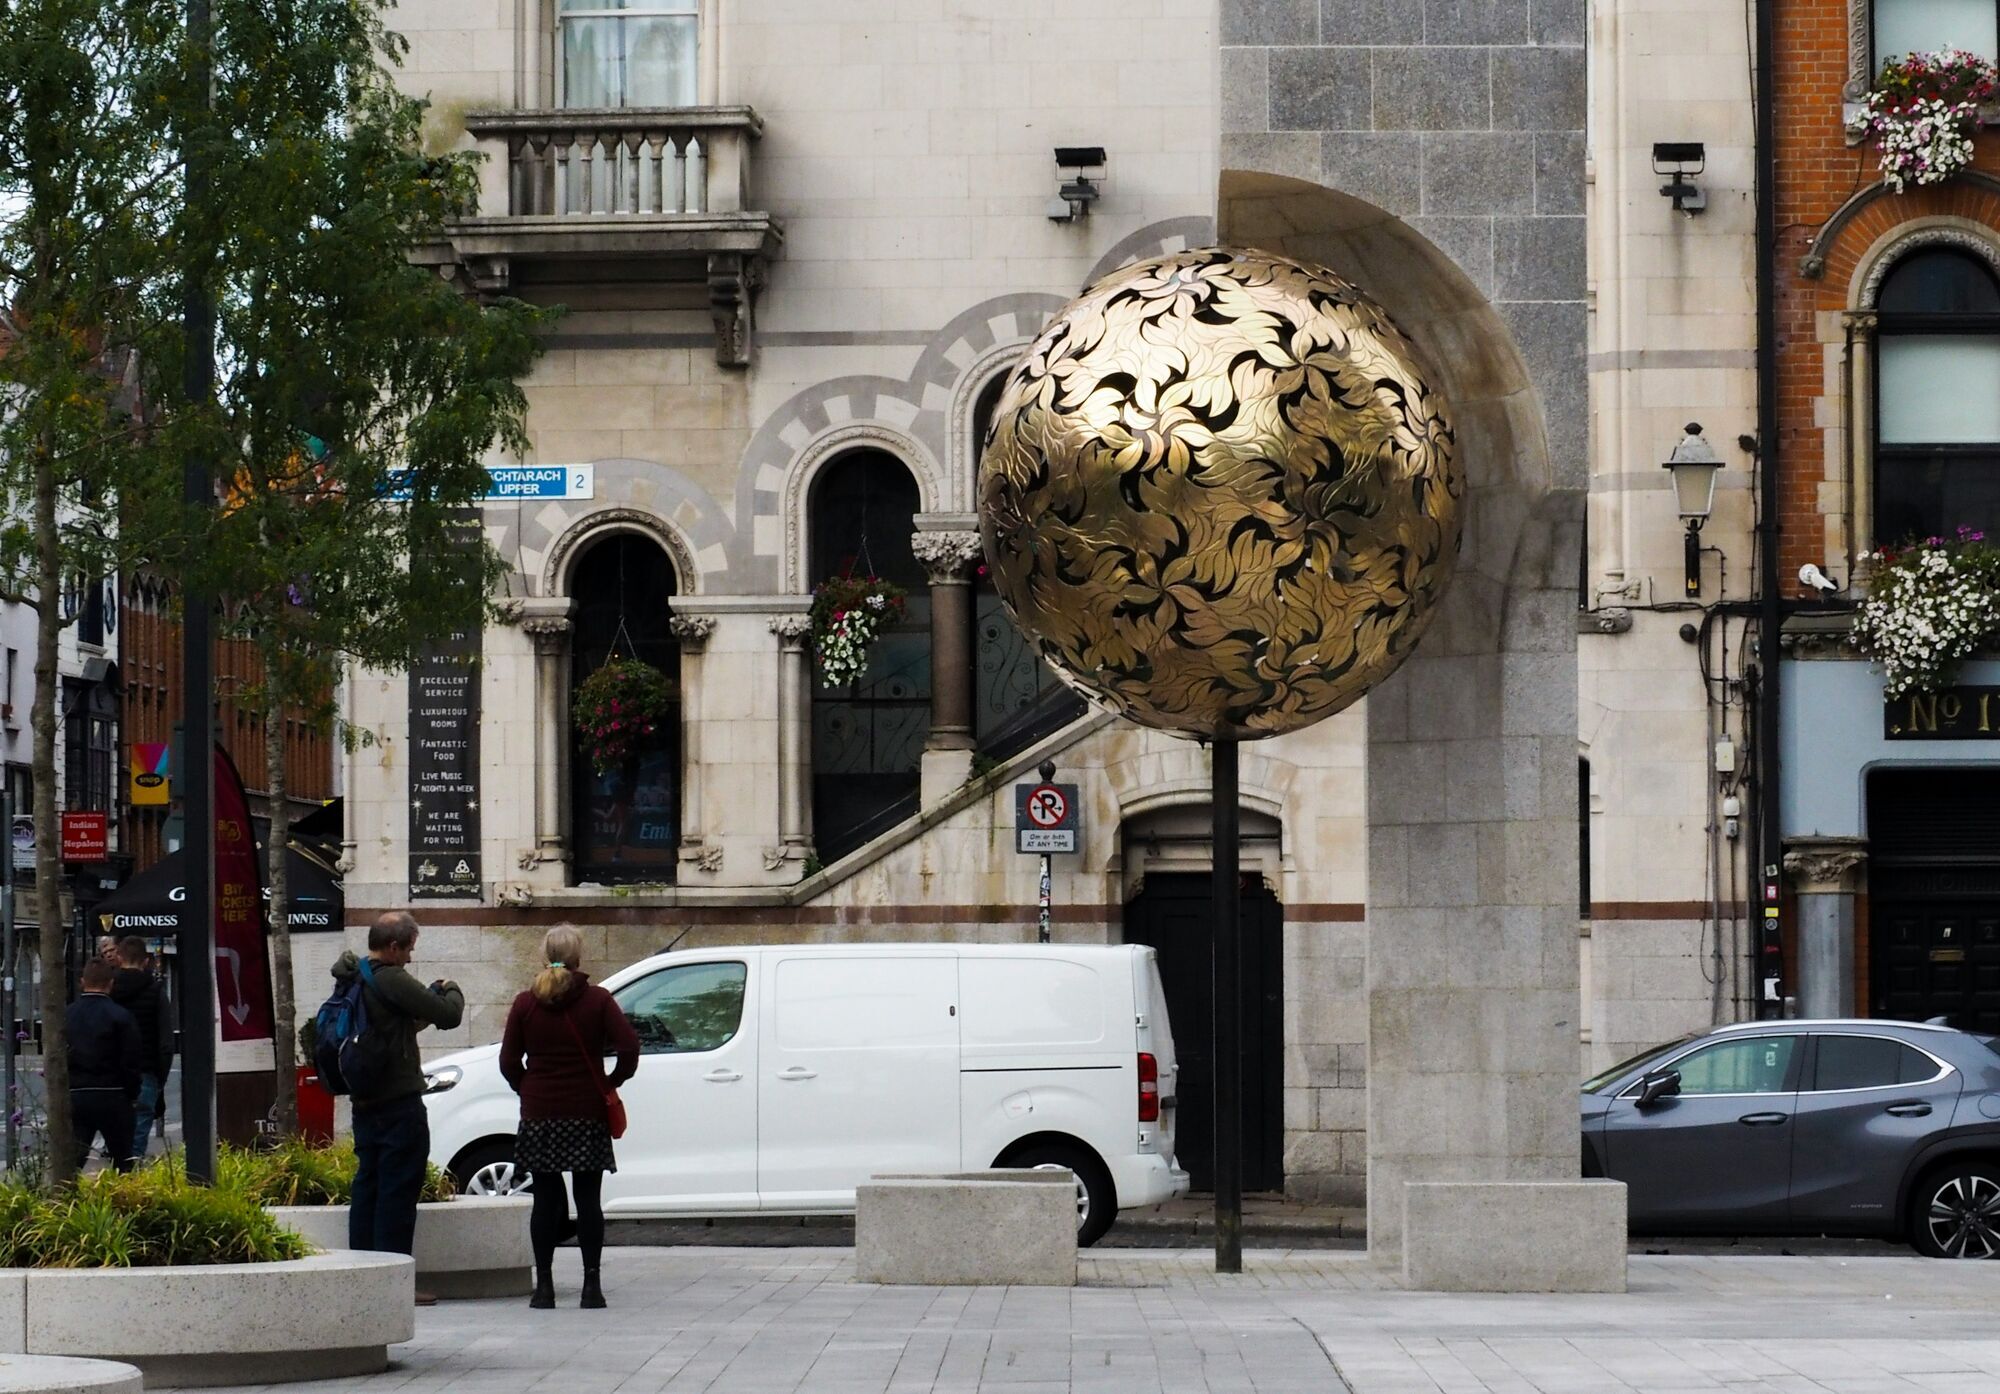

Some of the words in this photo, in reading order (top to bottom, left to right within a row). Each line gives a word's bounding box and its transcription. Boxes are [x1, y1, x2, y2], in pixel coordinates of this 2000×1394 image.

[576, 475, 584, 489] 2
[500, 484, 540, 494] UPPER
[420, 677, 469, 685] EXCELLENT
[425, 689, 463, 697] SERVICE
[420, 708, 468, 716] LUXURIOUS
[430, 720, 457, 728] ROOMS
[413, 783, 419, 792] 7
[428, 812, 439, 820] WE
[444, 812, 460, 820] ARE
[69, 821, 98, 829] Indian
[425, 824, 463, 832] WAITING
[80, 831, 88, 839] &
[423, 836, 440, 844] FOR
[444, 835, 464, 844] YOU!
[63, 840, 104, 849] Nepalese
[114, 914, 178, 928] GUINNESS
[268, 911, 329, 926] INNESS
